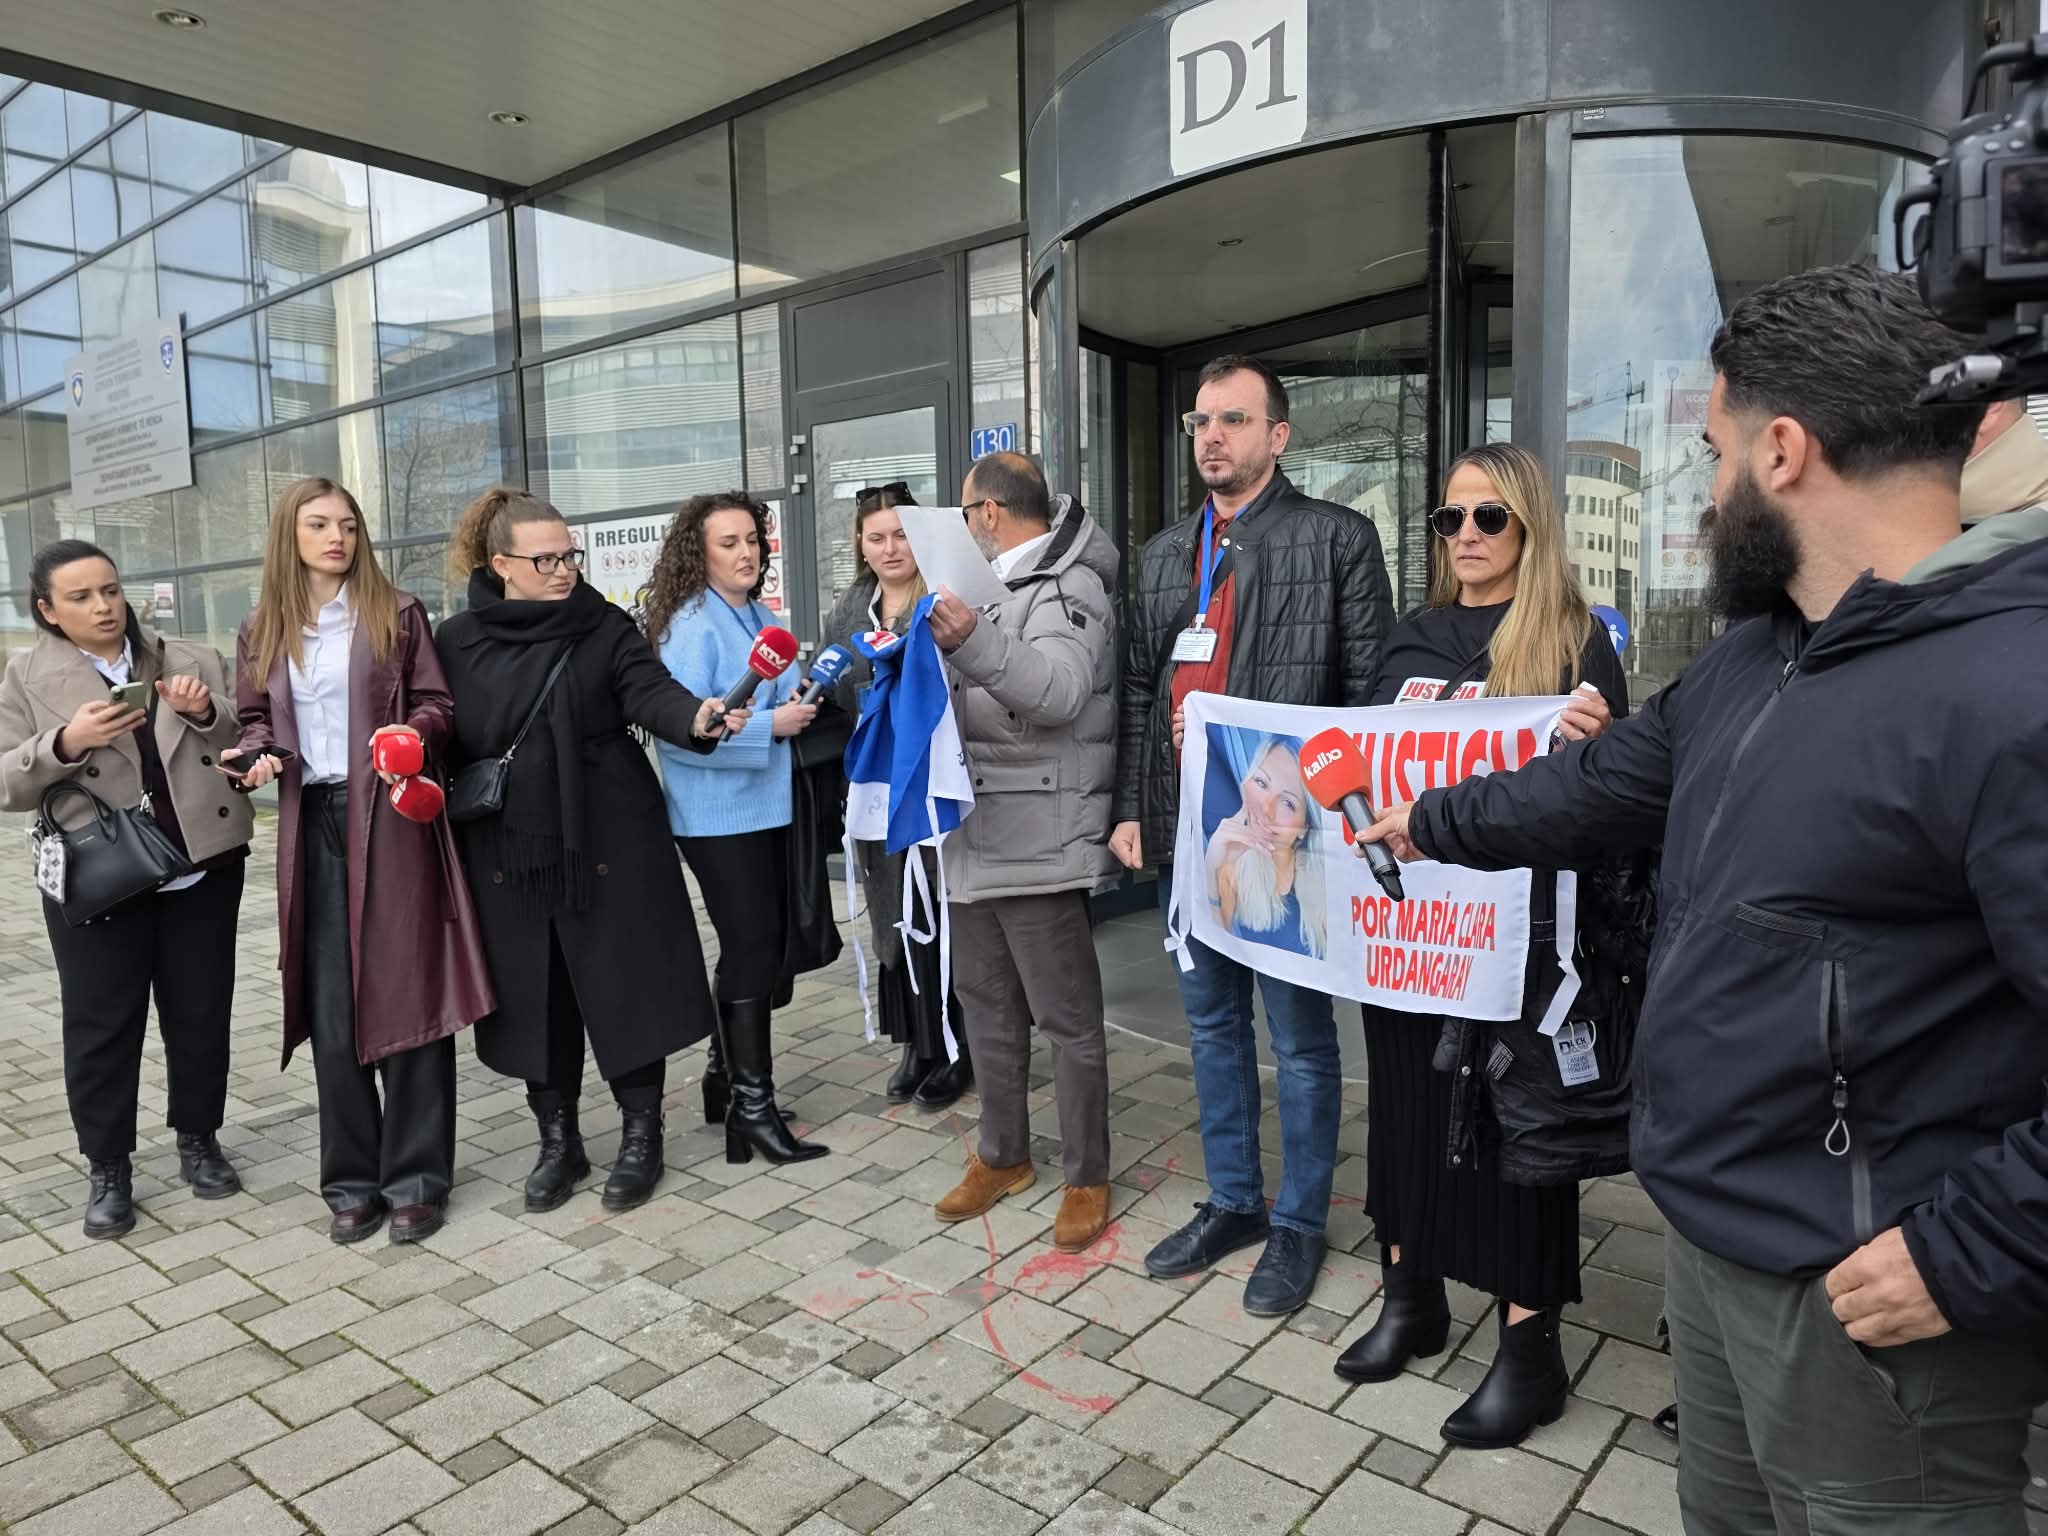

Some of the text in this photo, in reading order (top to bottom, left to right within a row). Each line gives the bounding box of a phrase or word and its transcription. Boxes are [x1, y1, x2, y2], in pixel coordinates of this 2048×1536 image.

[1177, 20, 1298, 134] D1
[977, 427, 1011, 457] 130
[757, 642, 788, 667] KTV
[1403, 681, 1478, 700] JUSTIA
[1342, 728, 1537, 846] USTIC
[1351, 890, 1496, 951] POR MARÍA CLARA
